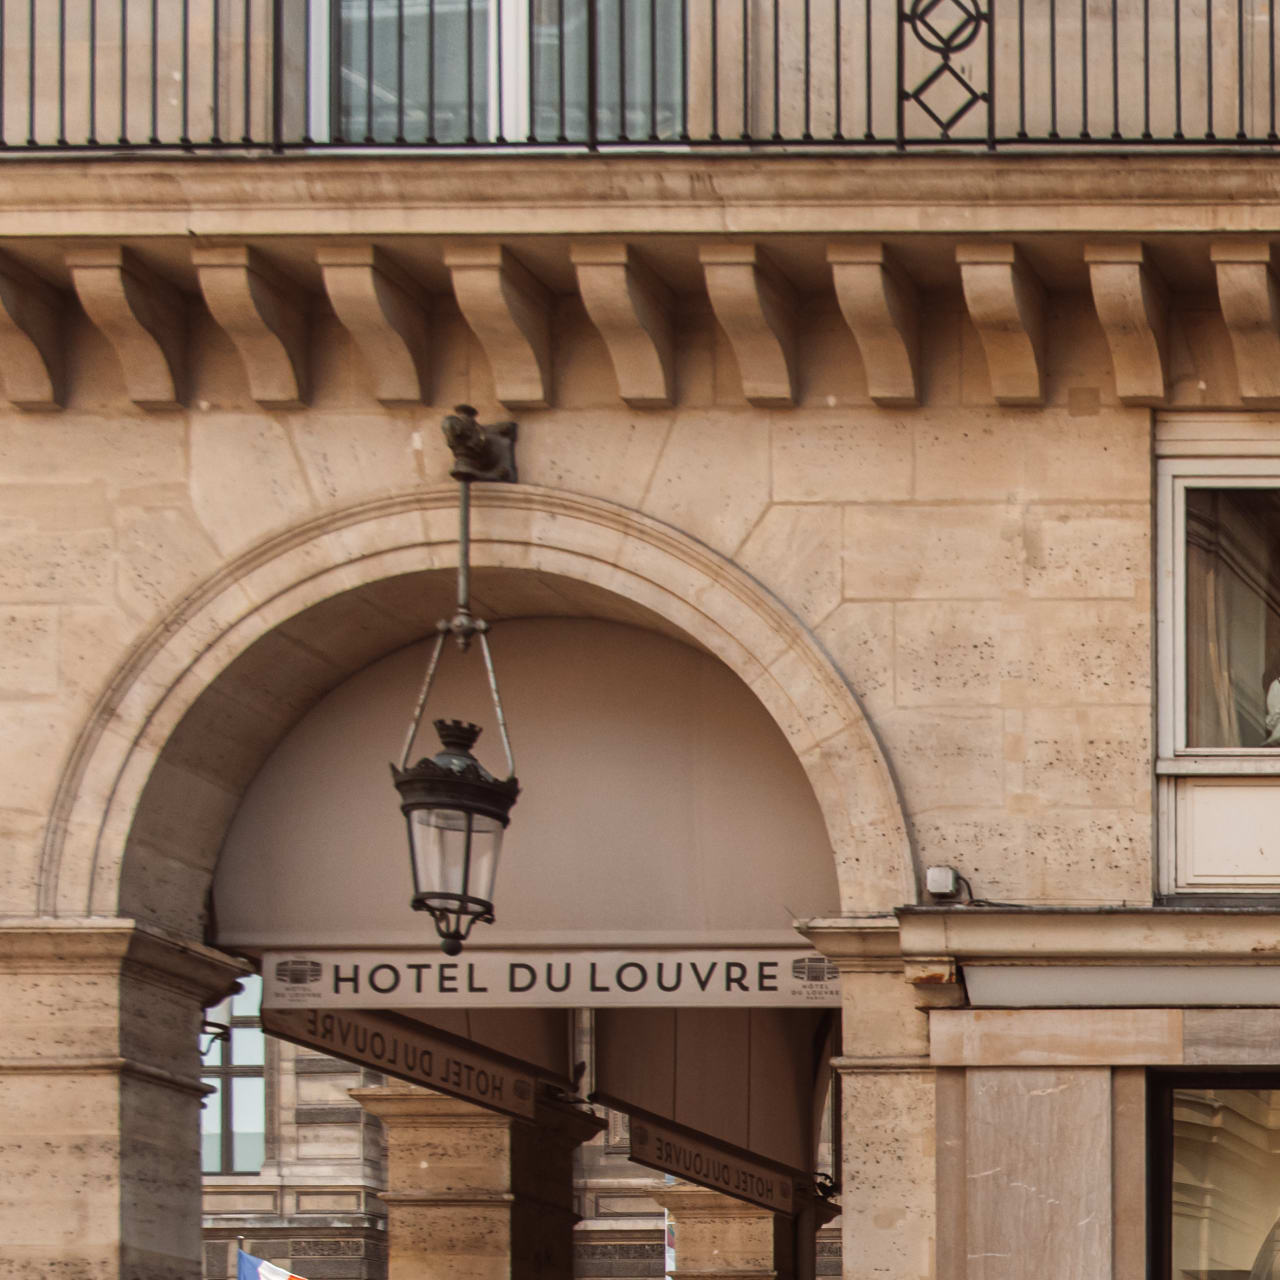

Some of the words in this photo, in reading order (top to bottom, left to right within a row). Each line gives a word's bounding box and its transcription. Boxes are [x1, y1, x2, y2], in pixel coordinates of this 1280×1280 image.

[333, 963, 488, 994] HOTEL
[509, 962, 571, 993] DU
[589, 962, 779, 993] LOUVRE
